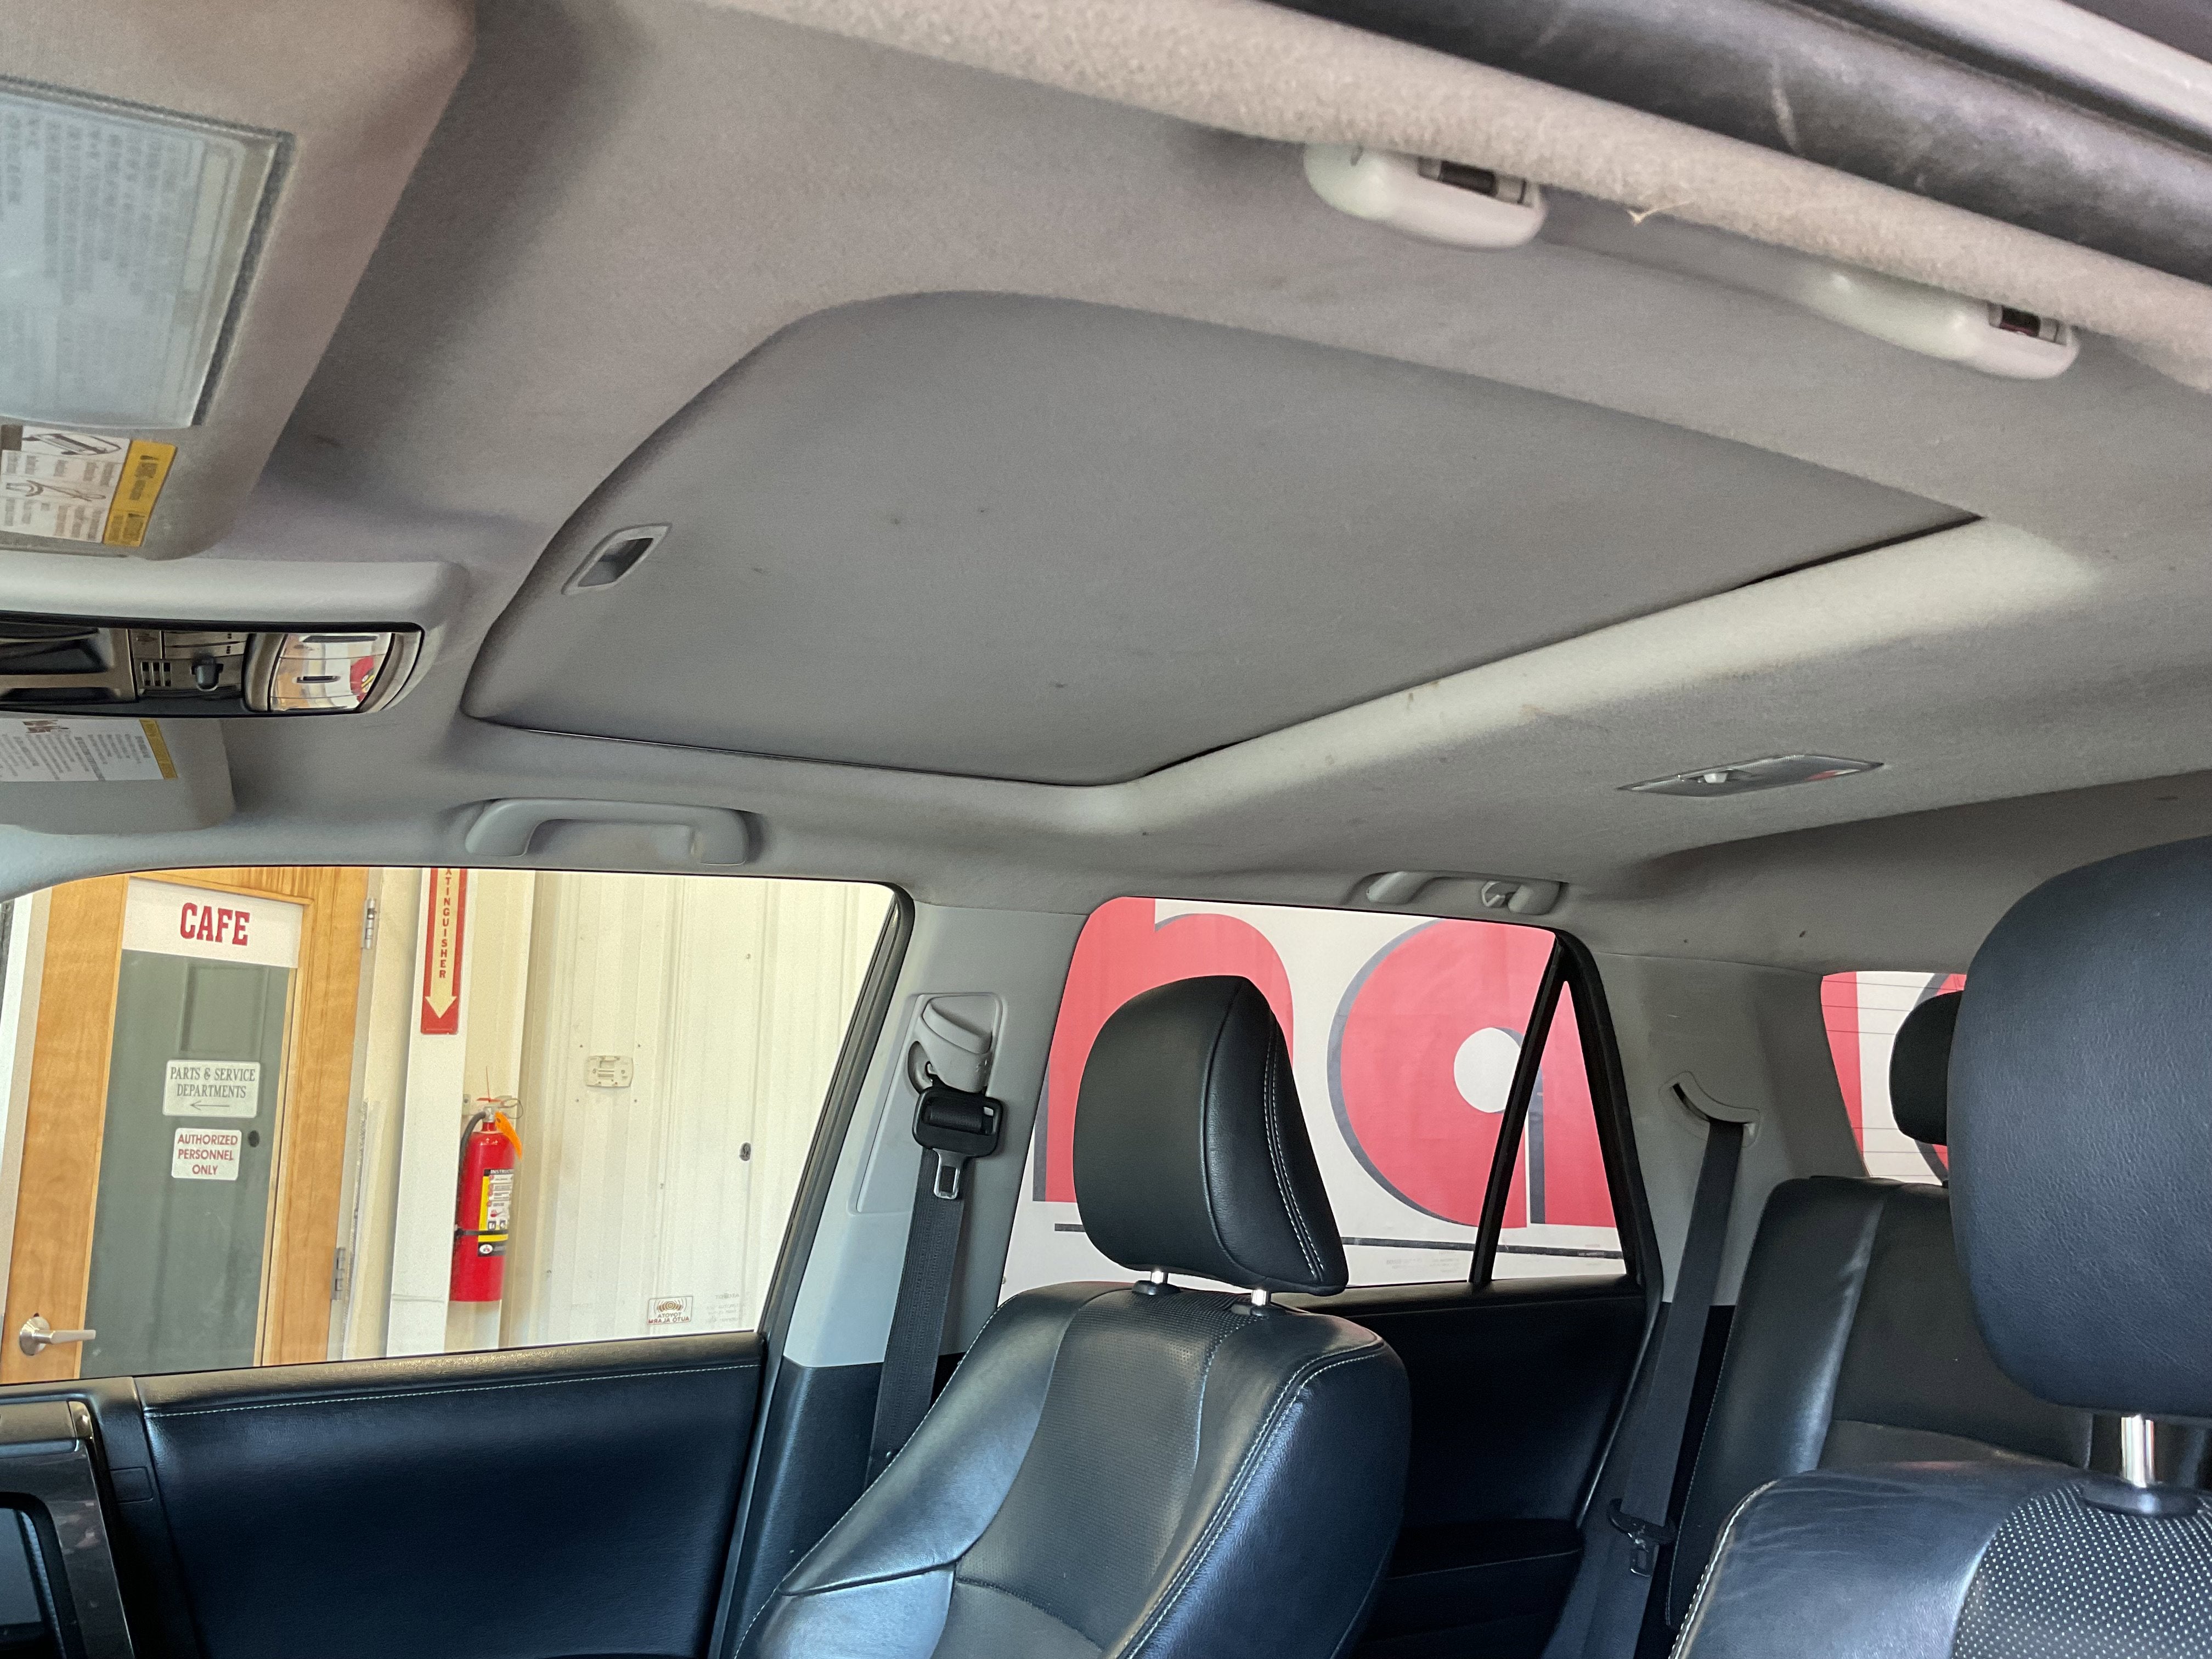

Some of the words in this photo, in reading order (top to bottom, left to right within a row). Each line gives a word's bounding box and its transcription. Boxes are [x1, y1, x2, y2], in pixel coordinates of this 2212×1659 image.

[180, 902, 250, 946] CAFE
[171, 1066, 200, 1080] PARTS
[204, 1068, 211, 1080] &
[214, 1068, 256, 1082] SERVICE
[177, 1084, 246, 1098] DEPARTMENTS
[178, 1133, 238, 1146] AUTHORIZED
[178, 1149, 234, 1161] PERSONNEL
[192, 1164, 218, 1175] ONLY
